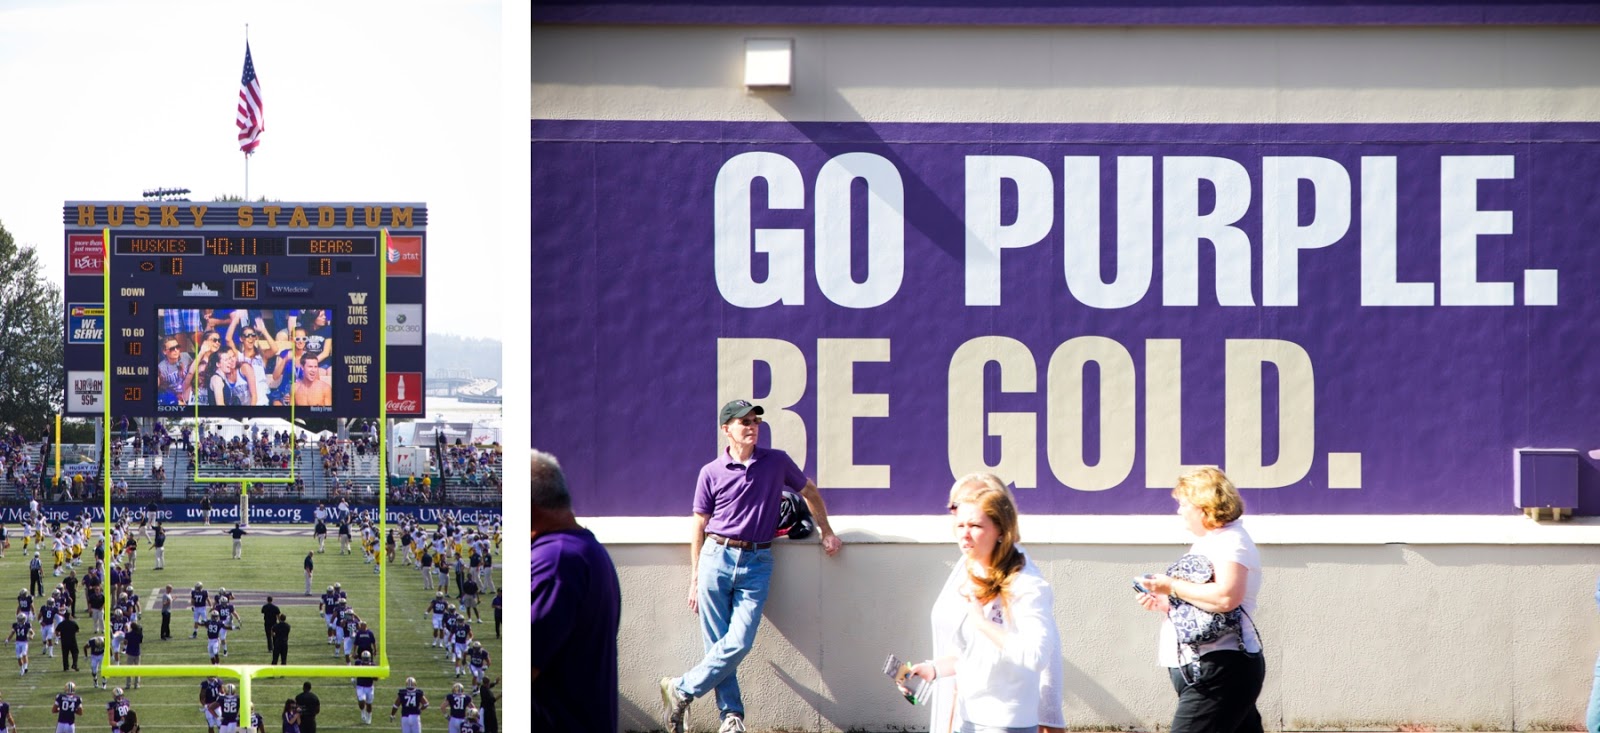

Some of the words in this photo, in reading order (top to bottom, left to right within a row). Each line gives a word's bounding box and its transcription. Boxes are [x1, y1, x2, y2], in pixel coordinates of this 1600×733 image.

[77, 205, 208, 227] HUSKY
[237, 206, 413, 227] STADIUM
[713, 151, 904, 309] GO
[964, 155, 1559, 309] PURPLE.
[131, 239, 186, 253] HUSKIES
[206, 238, 257, 255] 40:11
[310, 240, 353, 254] BEARS
[402, 252, 419, 261] at&t
[172, 257, 183, 275] 0
[223, 264, 257, 274] QUARTER
[320, 258, 331, 276] 0
[121, 288, 145, 297] DOWN
[241, 281, 256, 298] 16
[348, 306, 368, 315] TIME
[81, 319, 96, 329] WE
[347, 316, 369, 325] OUTS
[73, 329, 104, 339] SERVE
[121, 328, 132, 337] TO
[133, 328, 145, 337] GO
[344, 355, 372, 365] VISITOR
[116, 366, 135, 375] BALL
[137, 366, 149, 375] ON
[348, 365, 368, 374] TIME
[347, 374, 368, 384] OUTS
[717, 337, 891, 490] BE
[948, 336, 1362, 491] GOLD.
[194, 595, 203, 603] 77
[46, 610, 52, 619] 6
[404, 696, 416, 707] 74
[454, 698, 464, 710] 31
[223, 702, 237, 713] 92
